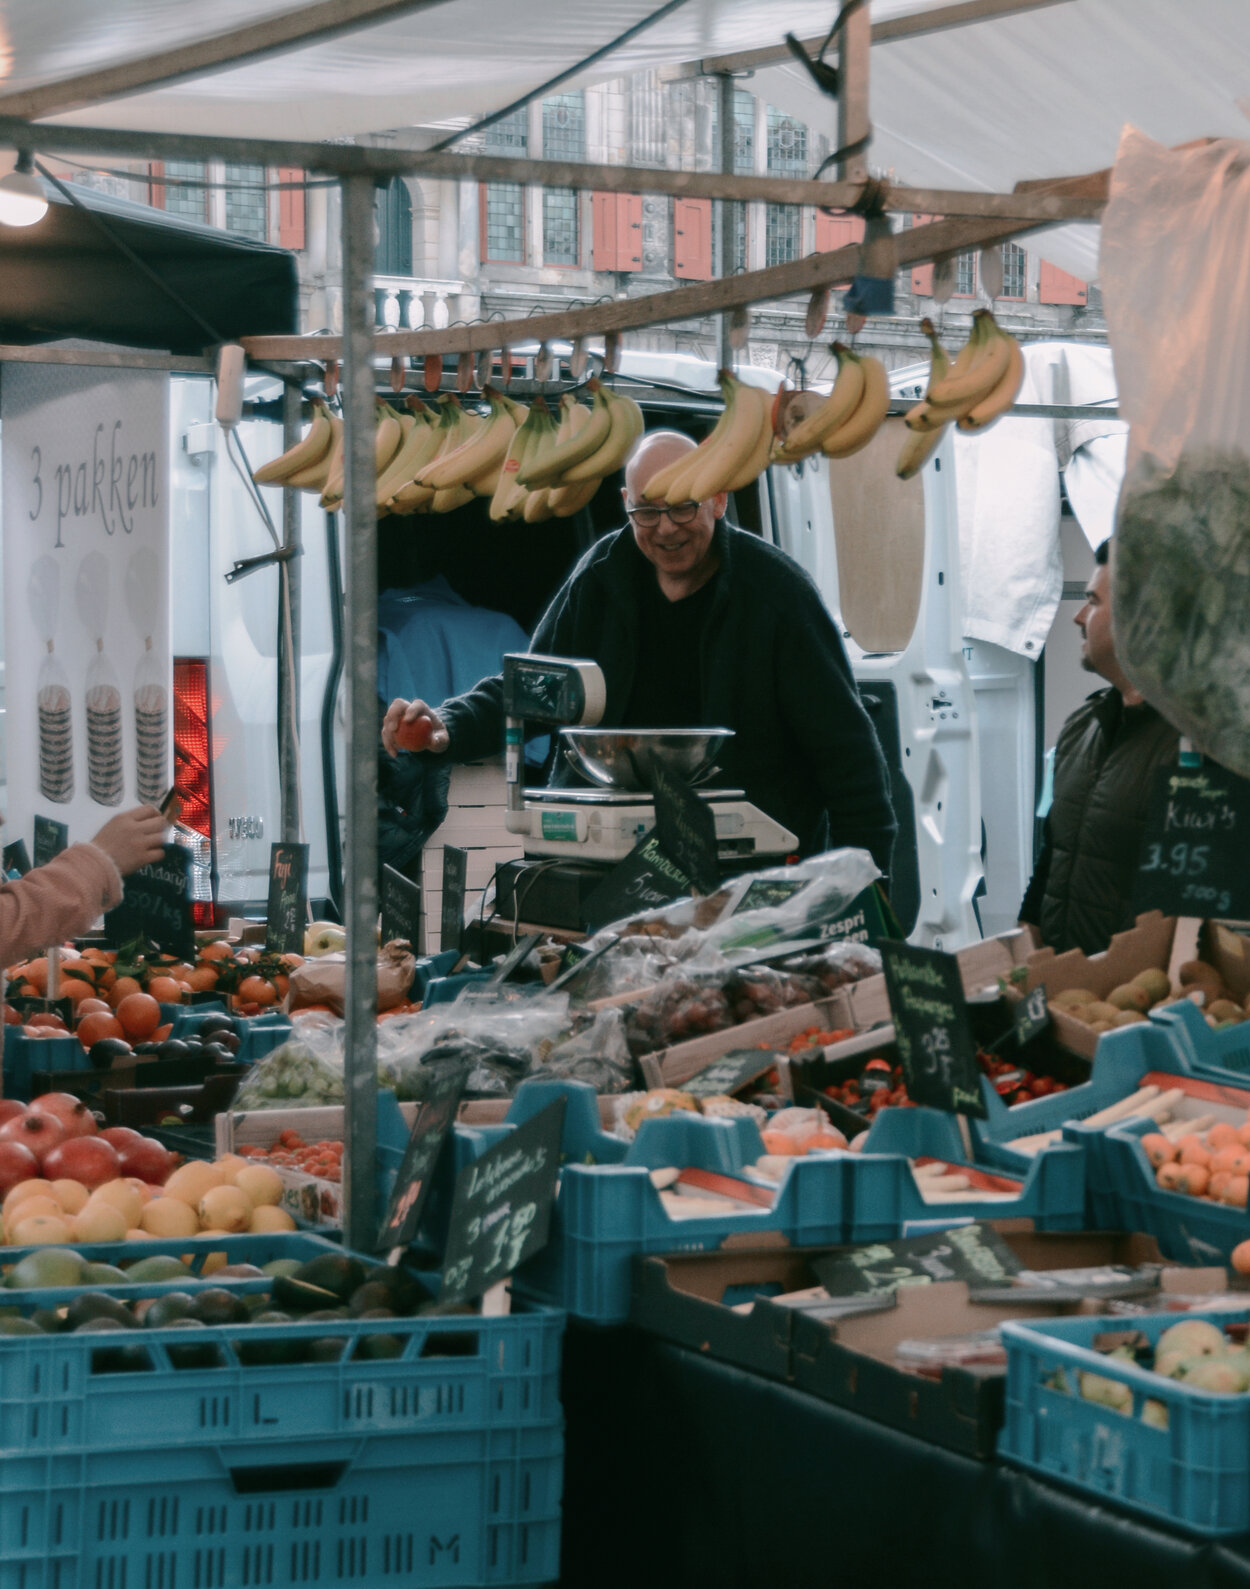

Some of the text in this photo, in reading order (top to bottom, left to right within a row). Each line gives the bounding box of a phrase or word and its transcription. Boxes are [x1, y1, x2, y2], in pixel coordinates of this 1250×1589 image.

[29, 419, 160, 549] 3 pakken
[1139, 842, 1211, 876] 3.95
[625, 871, 653, 895] 5
